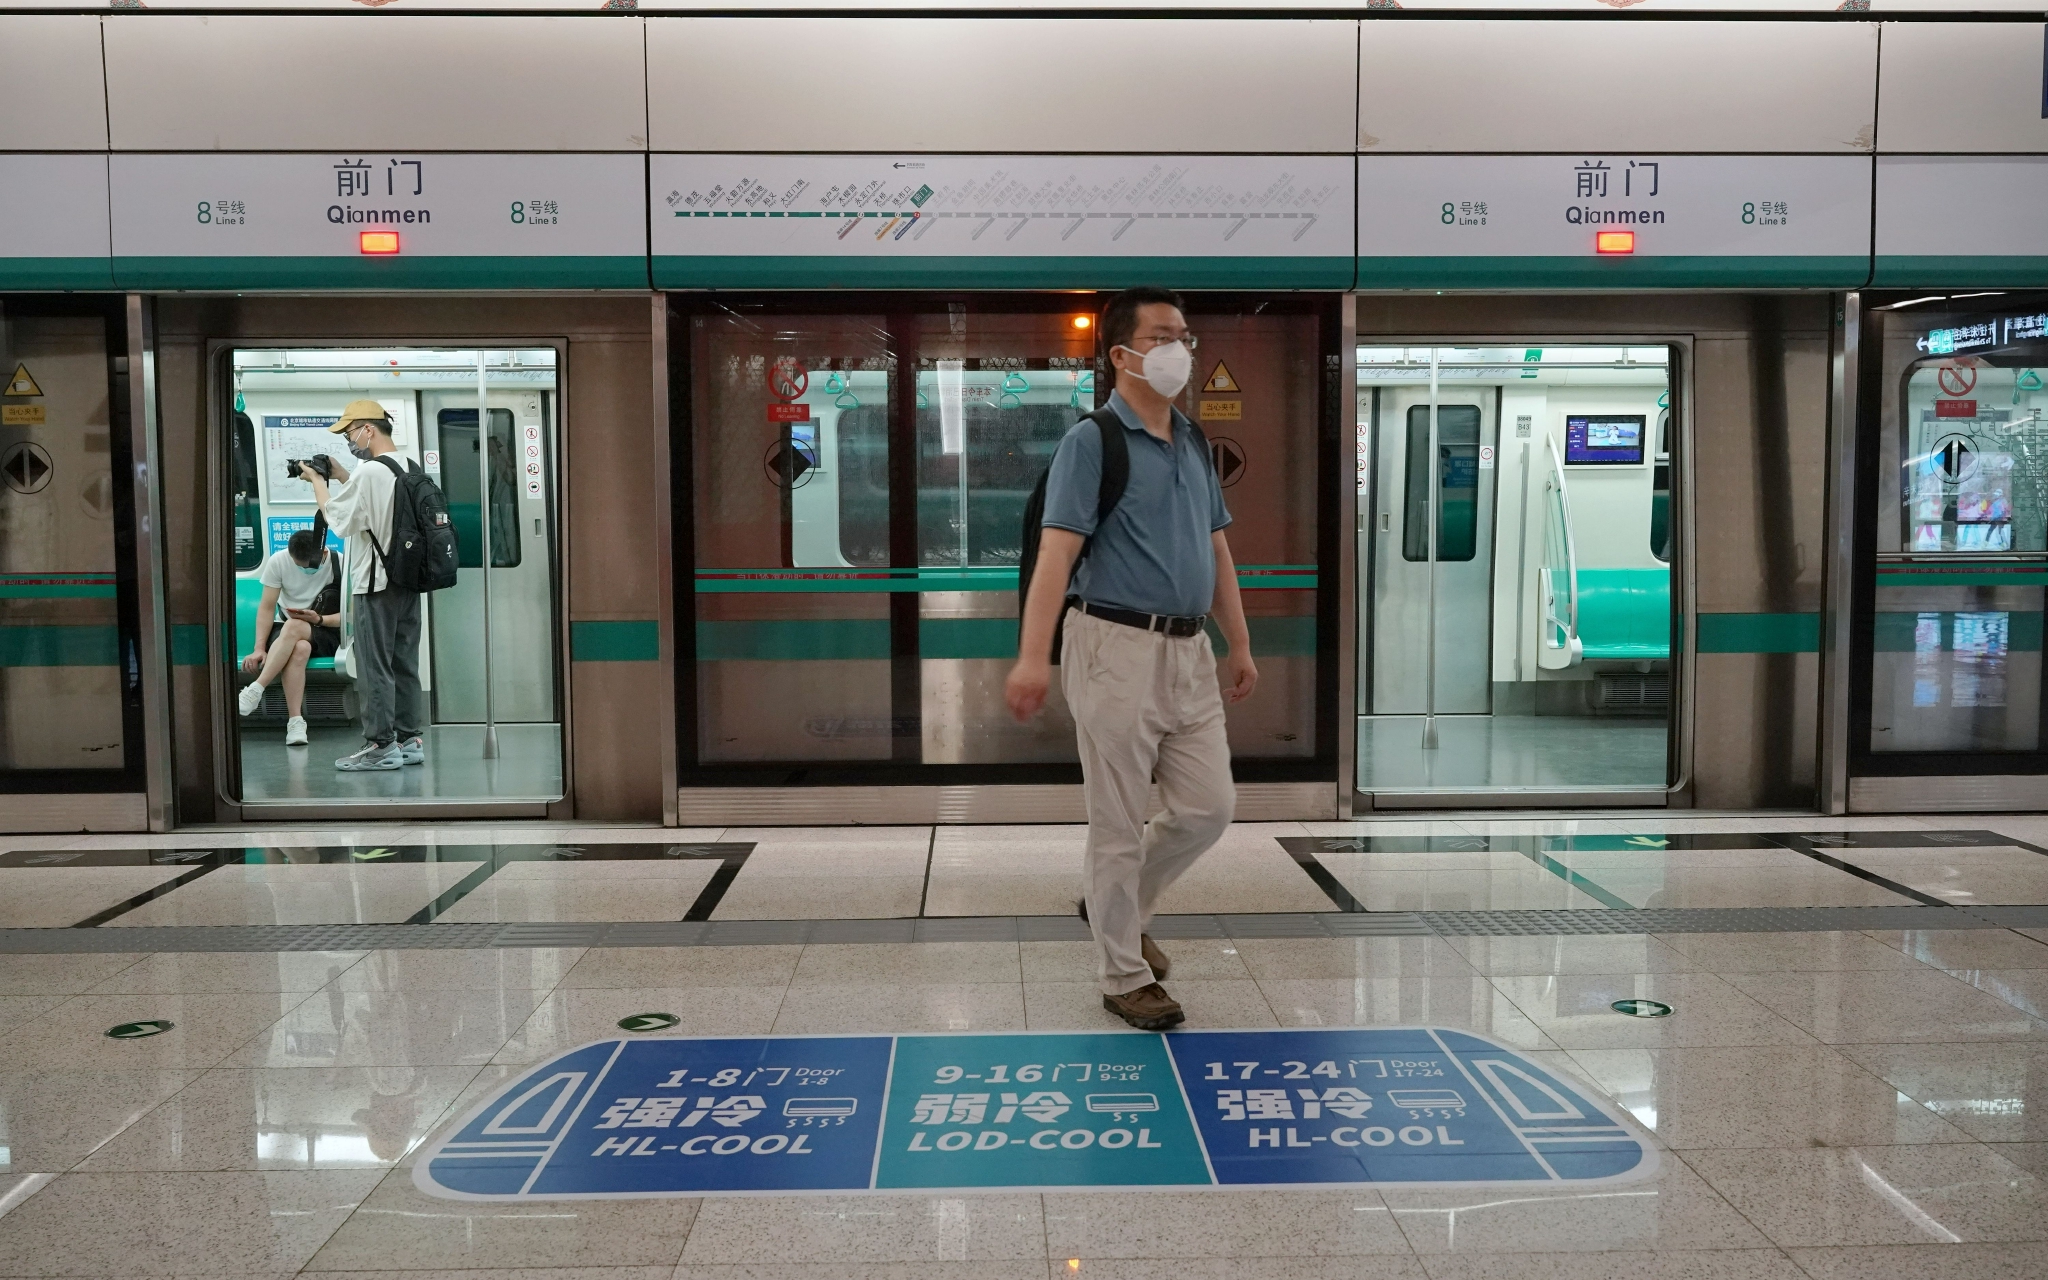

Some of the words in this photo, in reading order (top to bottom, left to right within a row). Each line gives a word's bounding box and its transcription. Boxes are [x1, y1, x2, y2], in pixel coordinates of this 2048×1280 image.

[333, 158, 423, 197] 前门
[1574, 160, 1659, 198] 前门
[327, 205, 431, 224] Qianmen
[1565, 206, 1665, 224] Qianmen
[215, 217, 236, 225] Line
[239, 217, 245, 225] 8
[529, 217, 549, 225] Line
[552, 217, 558, 225] 8
[1459, 217, 1478, 226] Line
[1480, 217, 1487, 226] 8
[1759, 217, 1778, 226] Line
[1781, 217, 1787, 226] 8
[1836, 311, 1843, 321] 15
[9, 407, 39, 415] 当心夹手
[1206, 403, 1236, 411] 当心夹手
[273, 532, 294, 541] 做好
[1098, 1063, 1146, 1072] Door
[1390, 1060, 1438, 1068] Door
[795, 1067, 846, 1077] Door
[933, 1063, 1092, 1084] 9-16门
[1204, 1059, 1388, 1080] 17-24门
[1394, 1068, 1445, 1078] 17-24
[656, 1067, 792, 1088] 1-8门
[798, 1077, 829, 1086] 1-8
[1099, 1073, 1140, 1081] 9-16
[909, 1091, 1073, 1125] 弱冷
[1217, 1087, 1373, 1121] 强冷
[592, 1095, 767, 1129] 强冷
[906, 1128, 1162, 1152] LOD-COOL
[1249, 1126, 1465, 1148] HL-COOL
[590, 1134, 813, 1156] HL-COOL
